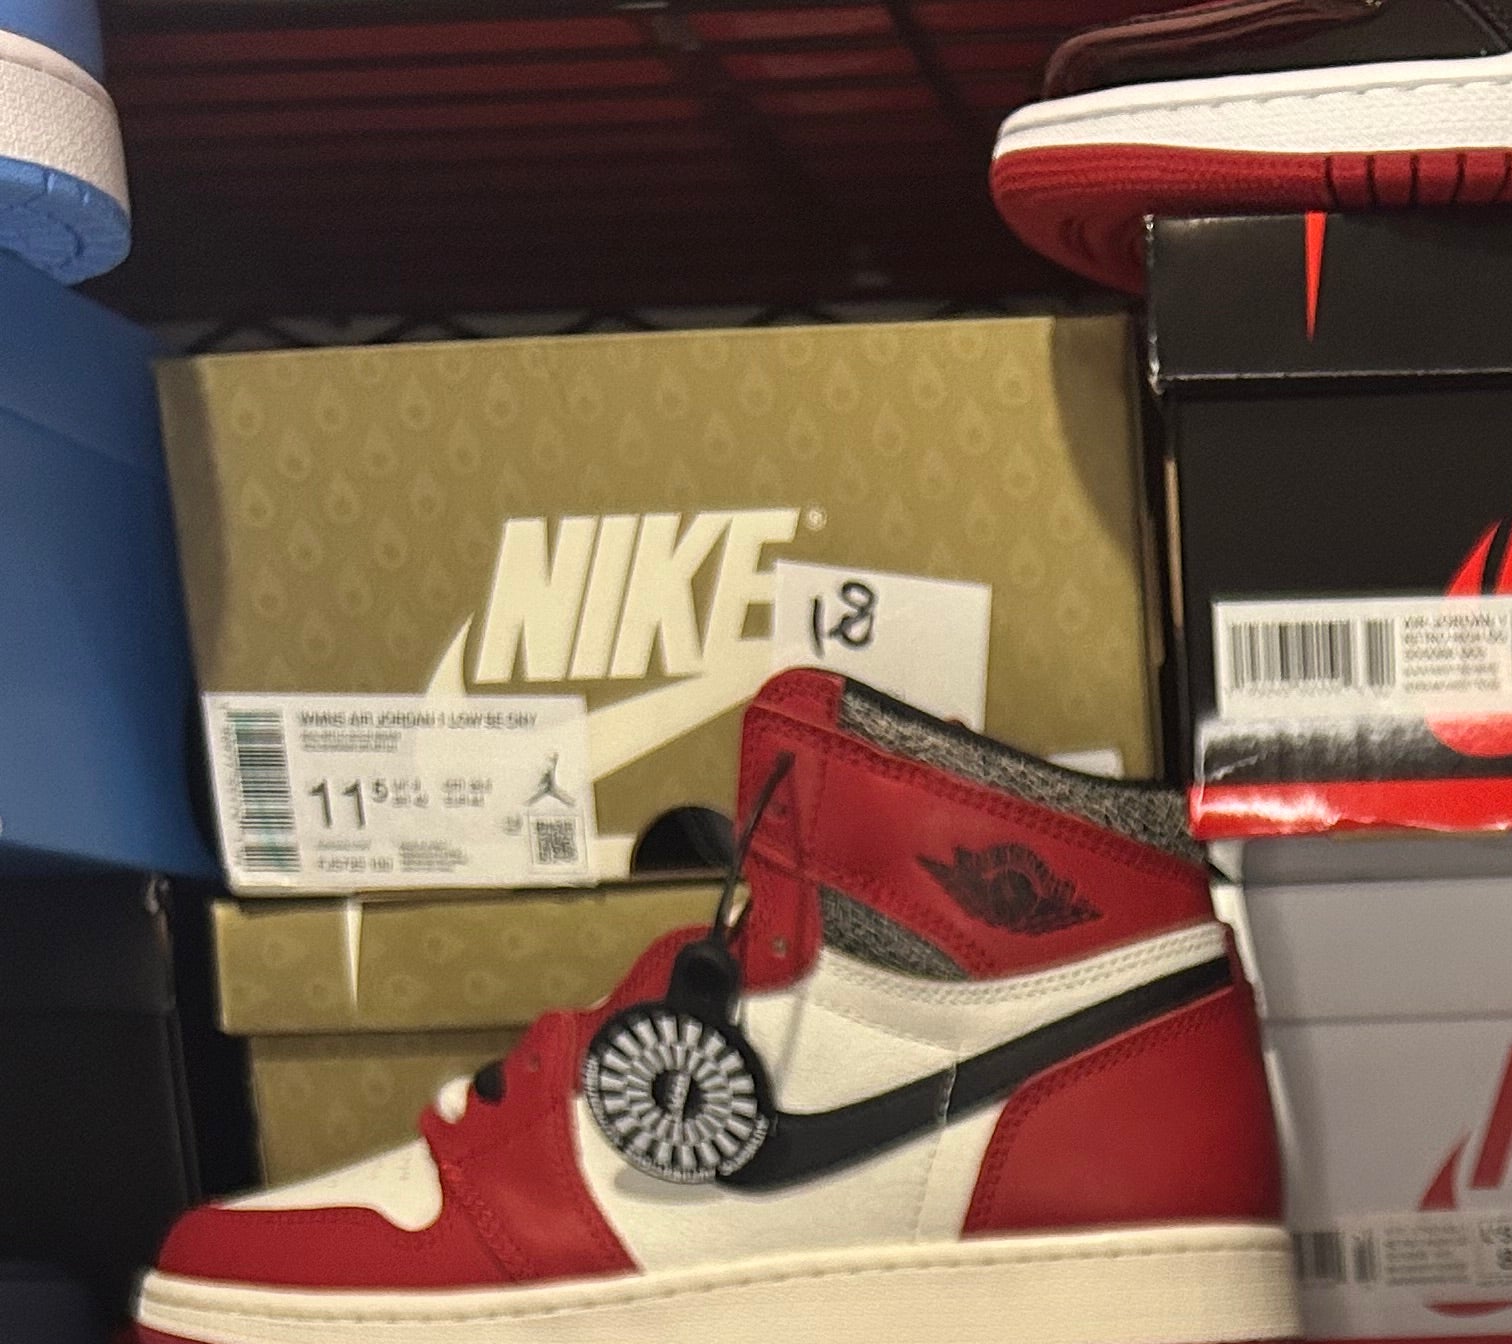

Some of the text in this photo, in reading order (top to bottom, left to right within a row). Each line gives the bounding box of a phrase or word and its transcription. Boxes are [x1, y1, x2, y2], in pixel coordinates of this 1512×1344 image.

[472, 507, 801, 685] NIKE
[811, 579, 877, 659] 18
[308, 777, 368, 830] 11
